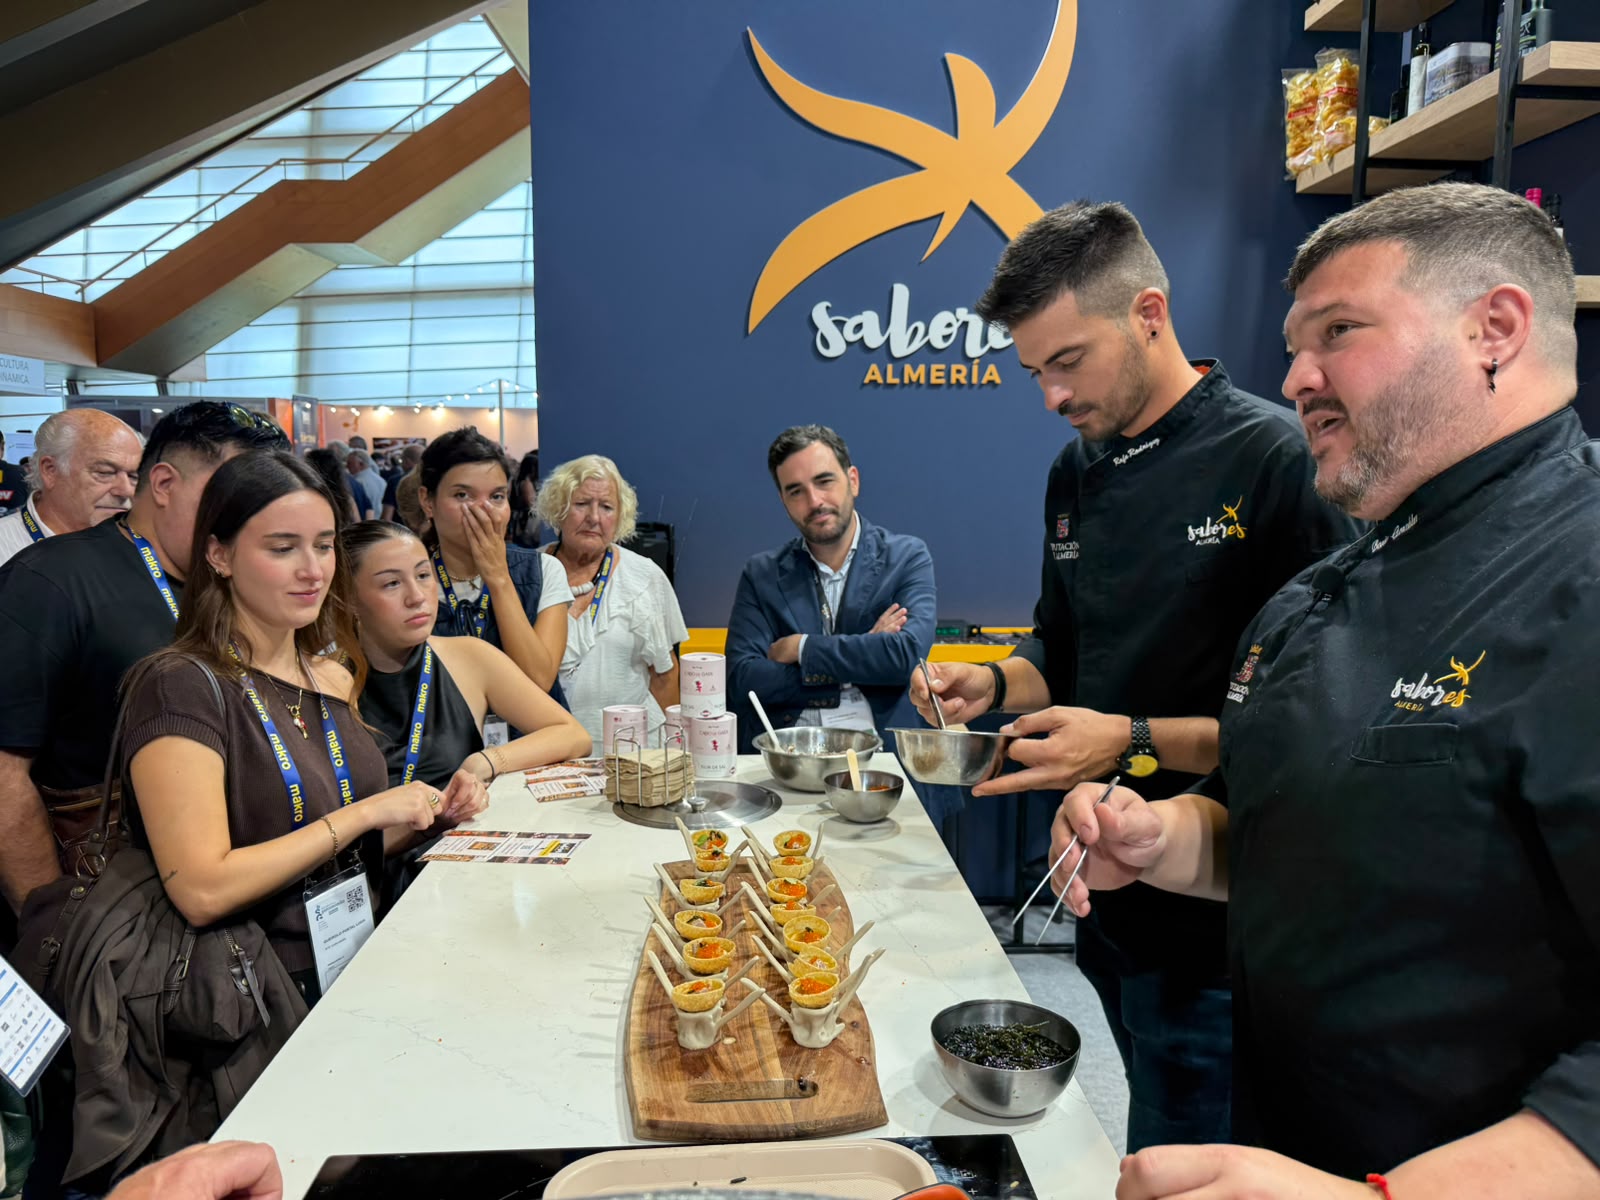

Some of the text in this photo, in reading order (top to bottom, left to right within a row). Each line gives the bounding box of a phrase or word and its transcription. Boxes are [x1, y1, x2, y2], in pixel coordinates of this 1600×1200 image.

[863, 359, 1001, 385] ALMERÍA
[140, 546, 162, 579] makro
[246, 688, 269, 722] makro
[417, 682, 429, 713] makro
[1390, 672, 1472, 708] sabores
[270, 733, 292, 770] makro
[326, 730, 344, 767] makro
[410, 722, 423, 754] makro
[289, 784, 305, 822] makro
